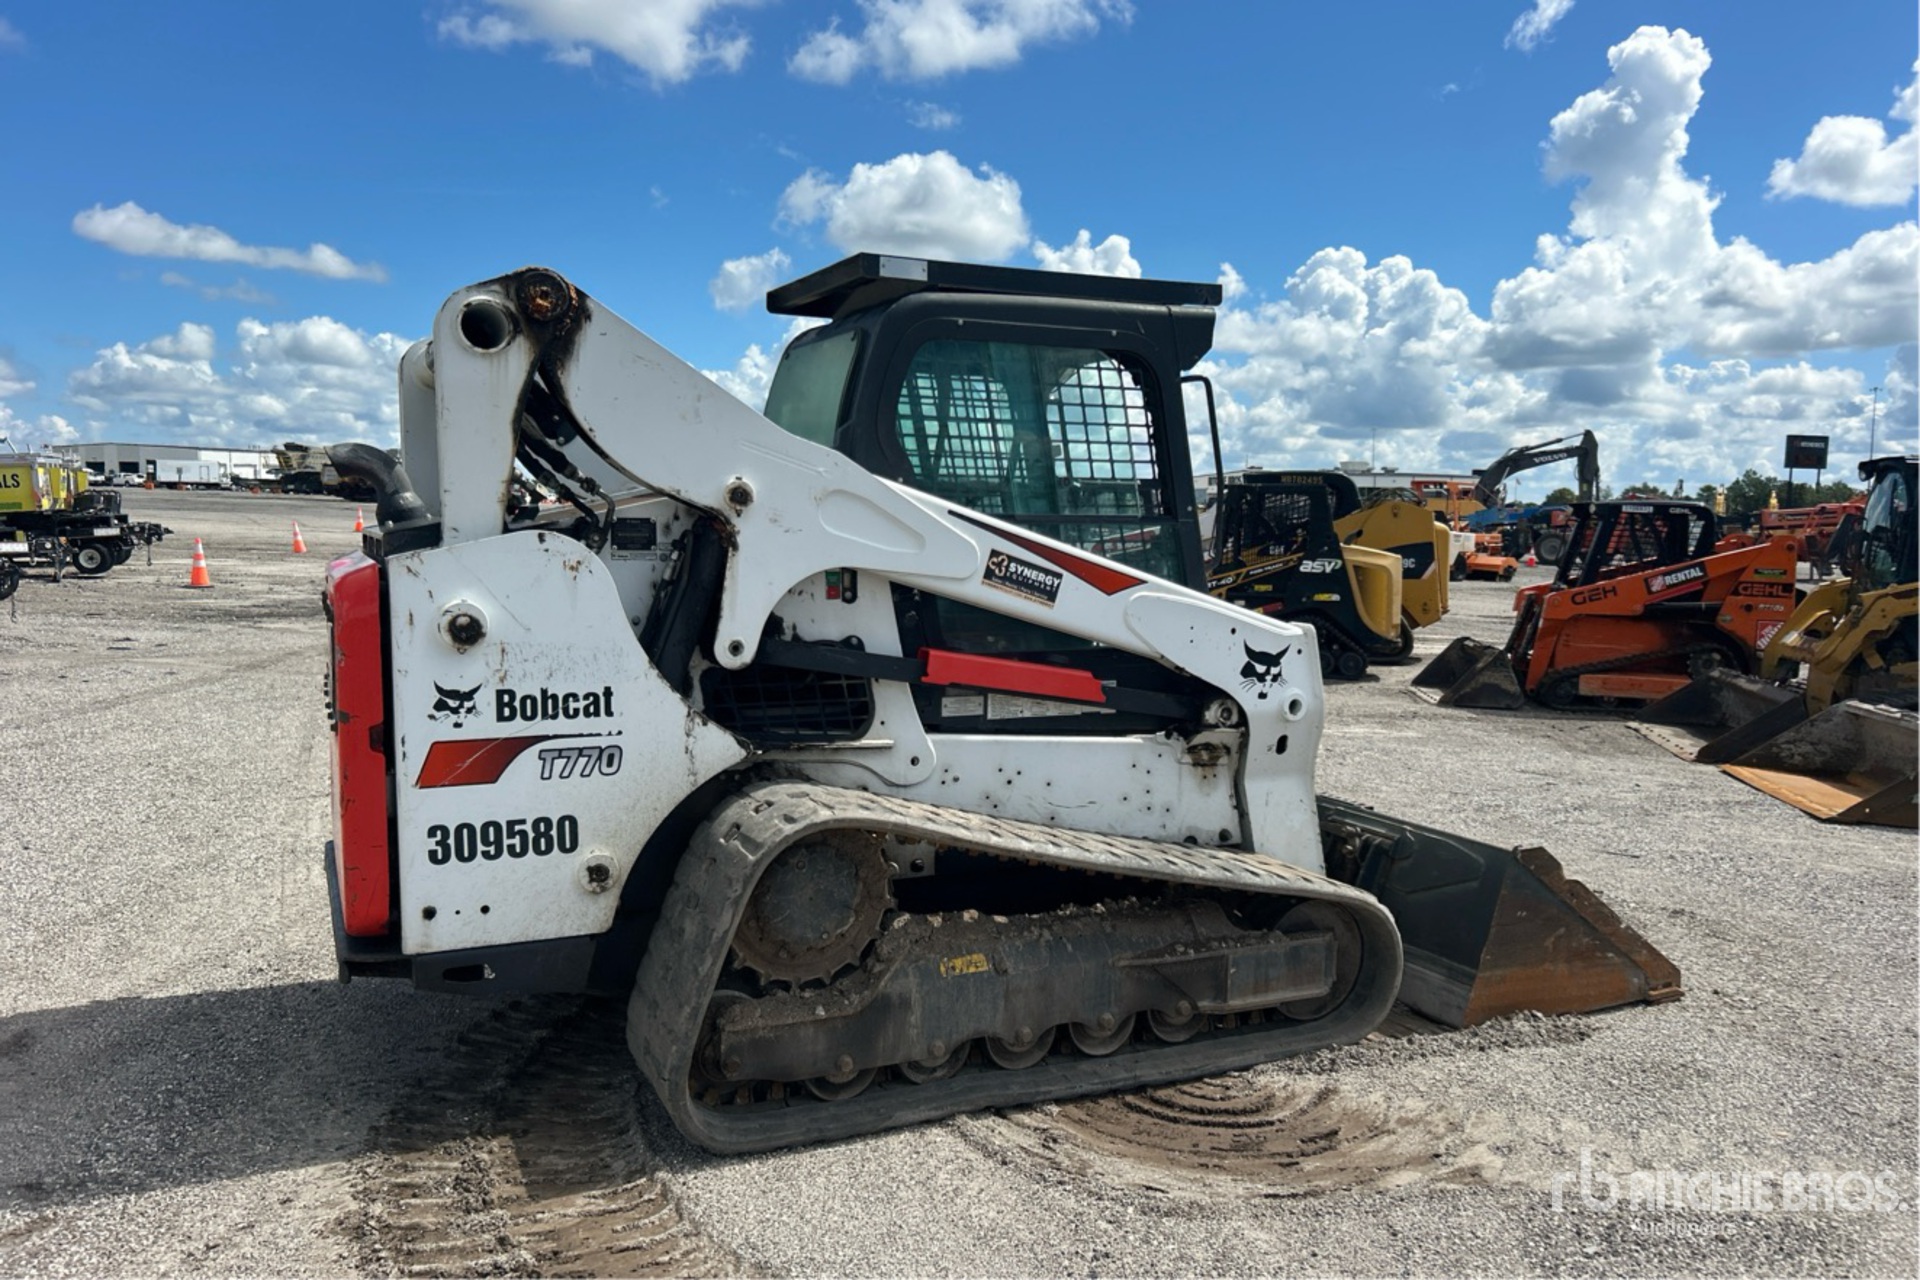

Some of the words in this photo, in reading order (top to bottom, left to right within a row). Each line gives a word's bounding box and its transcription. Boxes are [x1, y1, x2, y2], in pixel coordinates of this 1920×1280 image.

[1533, 452, 1568, 464] VOLVO
[0, 473, 20, 489] LS
[1009, 562, 1060, 587] SYNERGY
[1663, 567, 1704, 586] RENTAL
[1738, 583, 1792, 597] GEHL
[495, 686, 615, 723] Bobcat
[538, 745, 623, 780] T770
[427, 814, 579, 866] 309580
